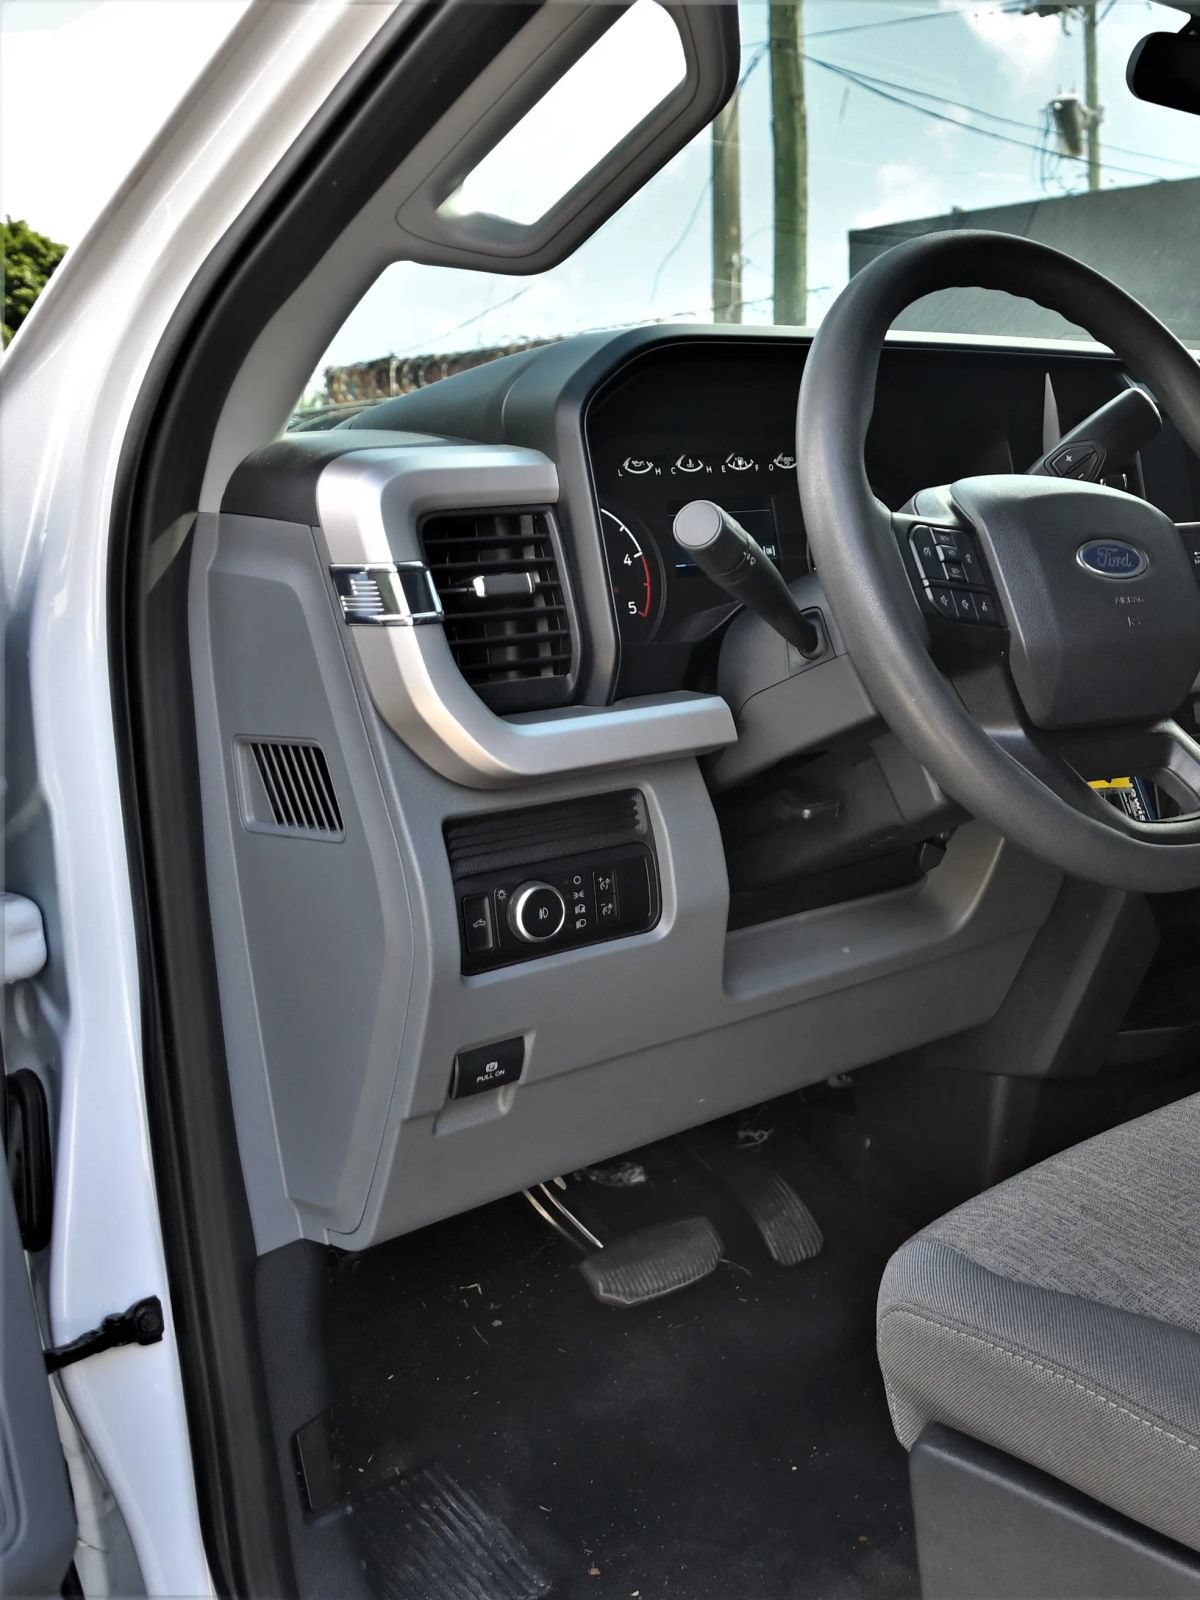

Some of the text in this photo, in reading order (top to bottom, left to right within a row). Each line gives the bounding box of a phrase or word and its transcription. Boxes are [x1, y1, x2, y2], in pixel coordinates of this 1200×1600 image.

[617, 467, 662, 477] L H
[670, 465, 713, 475] C H
[720, 463, 760, 473] E F
[623, 553, 633, 567] 4
[1097, 547, 1132, 568] Ford
[627, 600, 638, 615] 5
[476, 1073, 493, 1082] PULL
